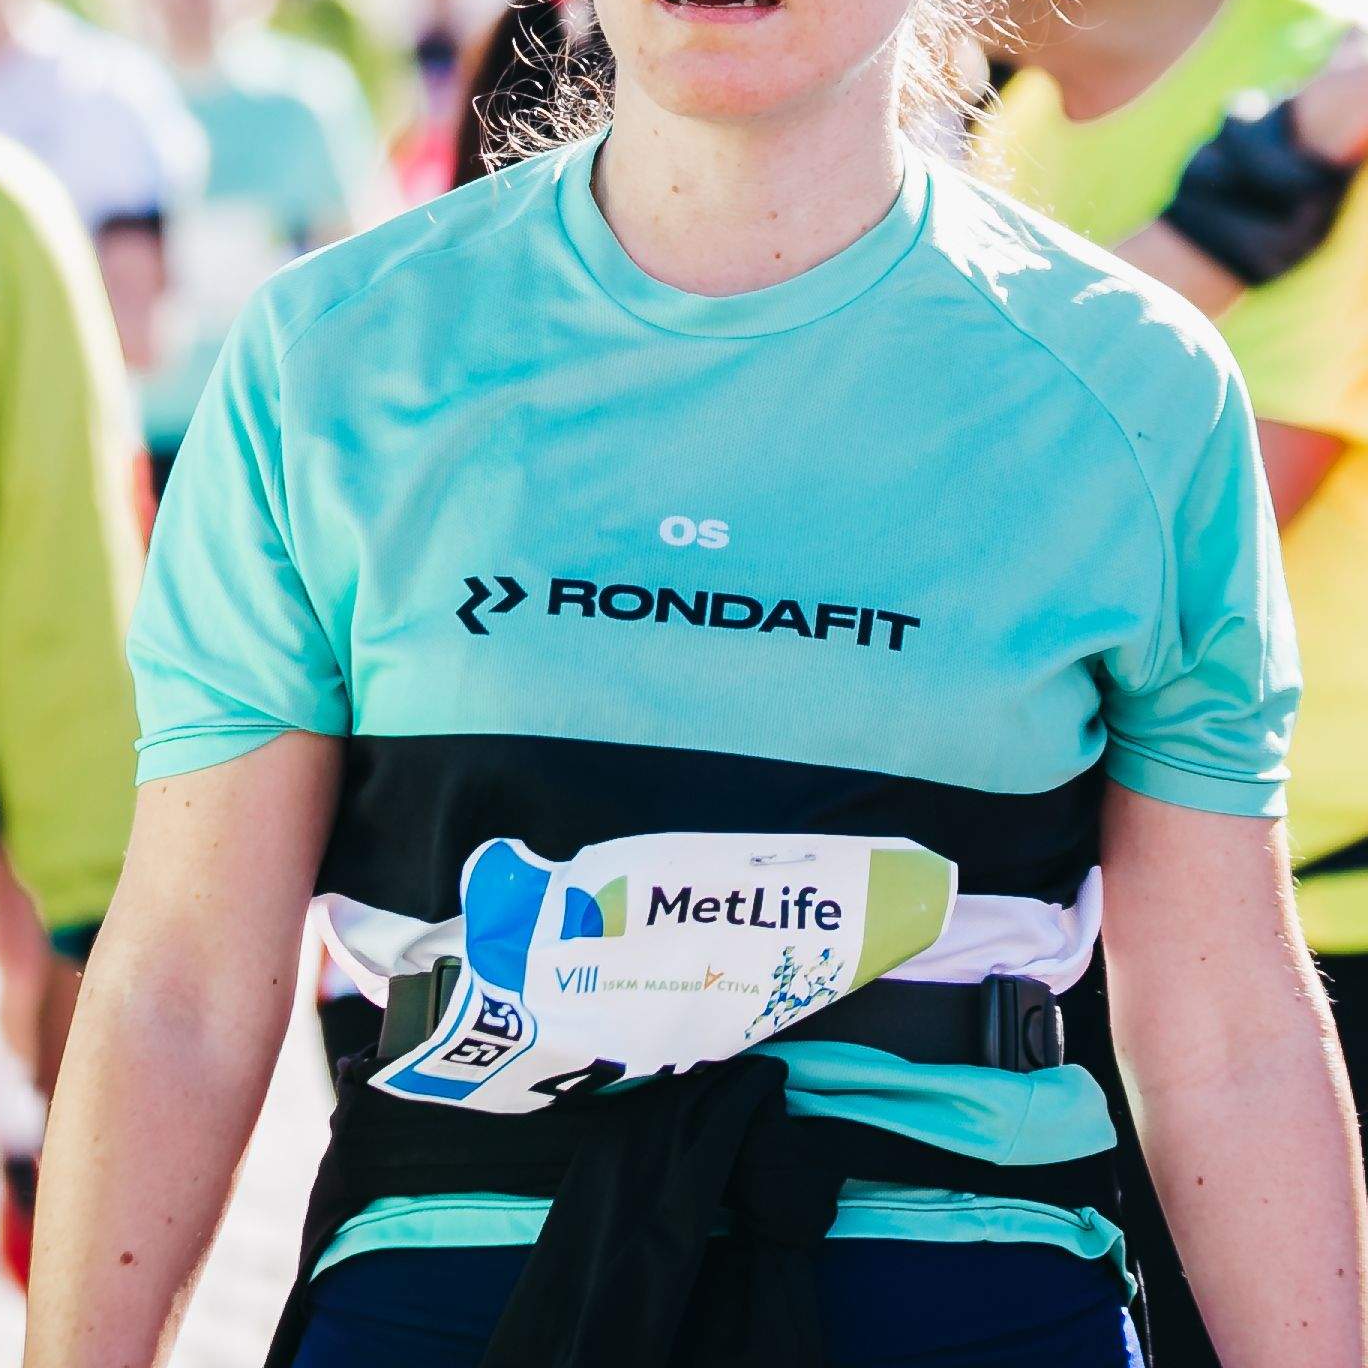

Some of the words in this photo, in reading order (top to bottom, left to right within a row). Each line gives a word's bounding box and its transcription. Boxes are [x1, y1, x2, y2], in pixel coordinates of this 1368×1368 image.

[659, 515, 730, 550] OS
[547, 578, 921, 652] RONDAFIT
[647, 886, 843, 931] MetLife
[554, 965, 599, 994] VIII
